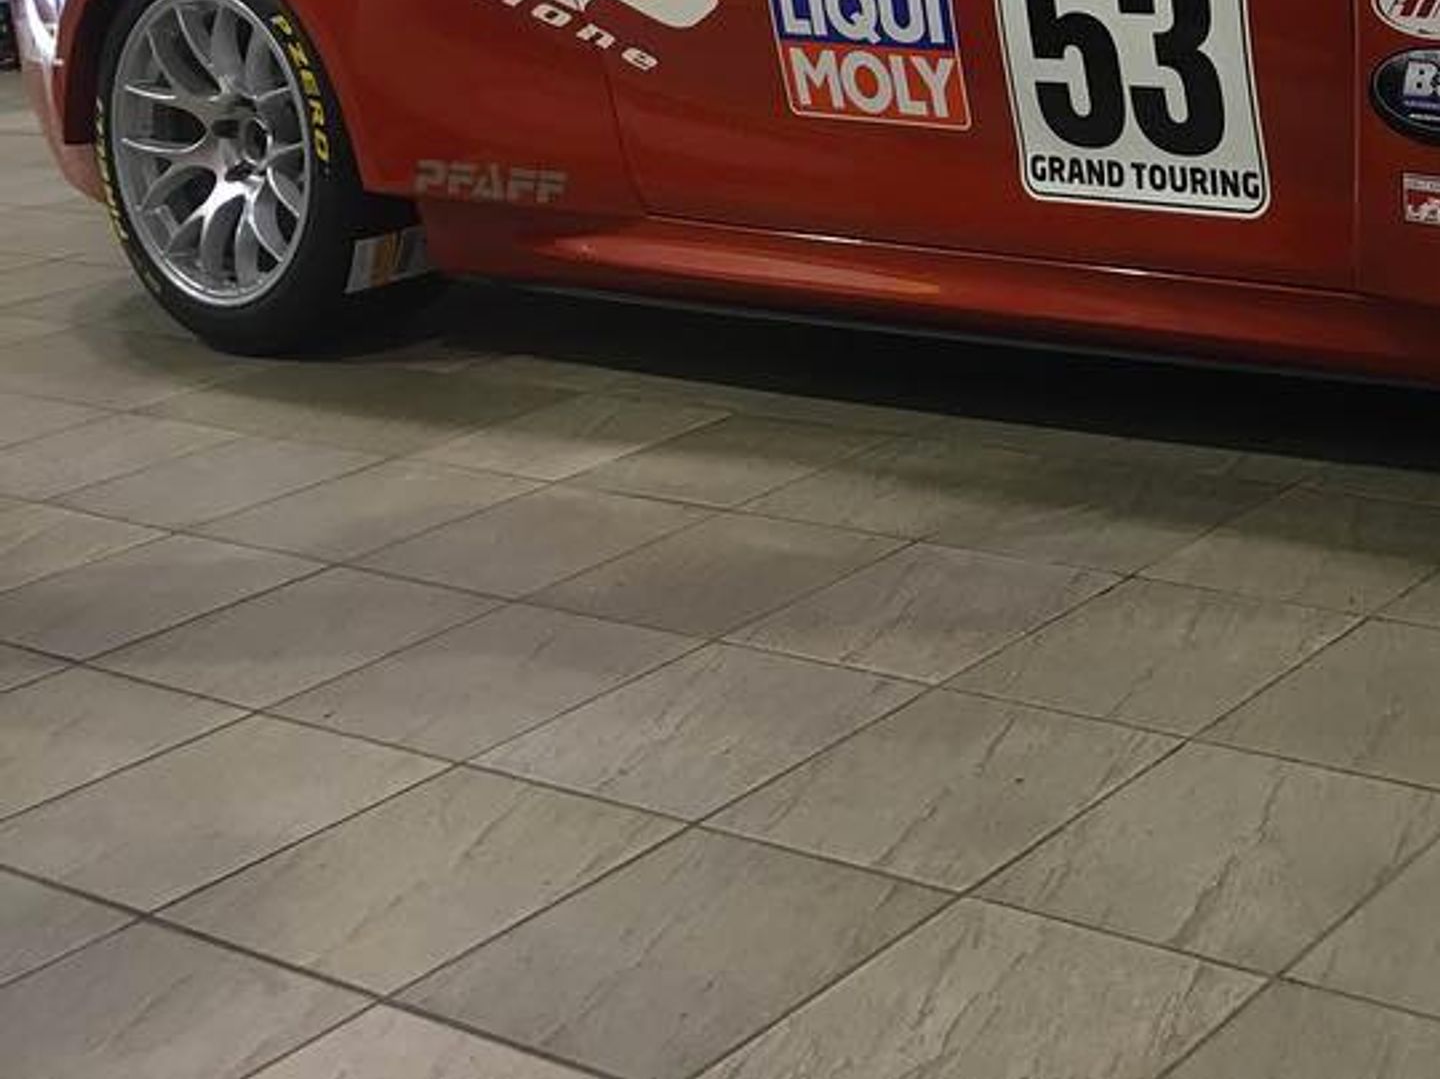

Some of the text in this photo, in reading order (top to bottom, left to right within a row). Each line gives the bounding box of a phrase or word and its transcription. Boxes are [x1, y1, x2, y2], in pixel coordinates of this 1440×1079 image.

[789, 46, 958, 118] MOLY
[414, 158, 569, 204] PFAFF
[1031, 154, 1261, 200] GRAND TOURING
